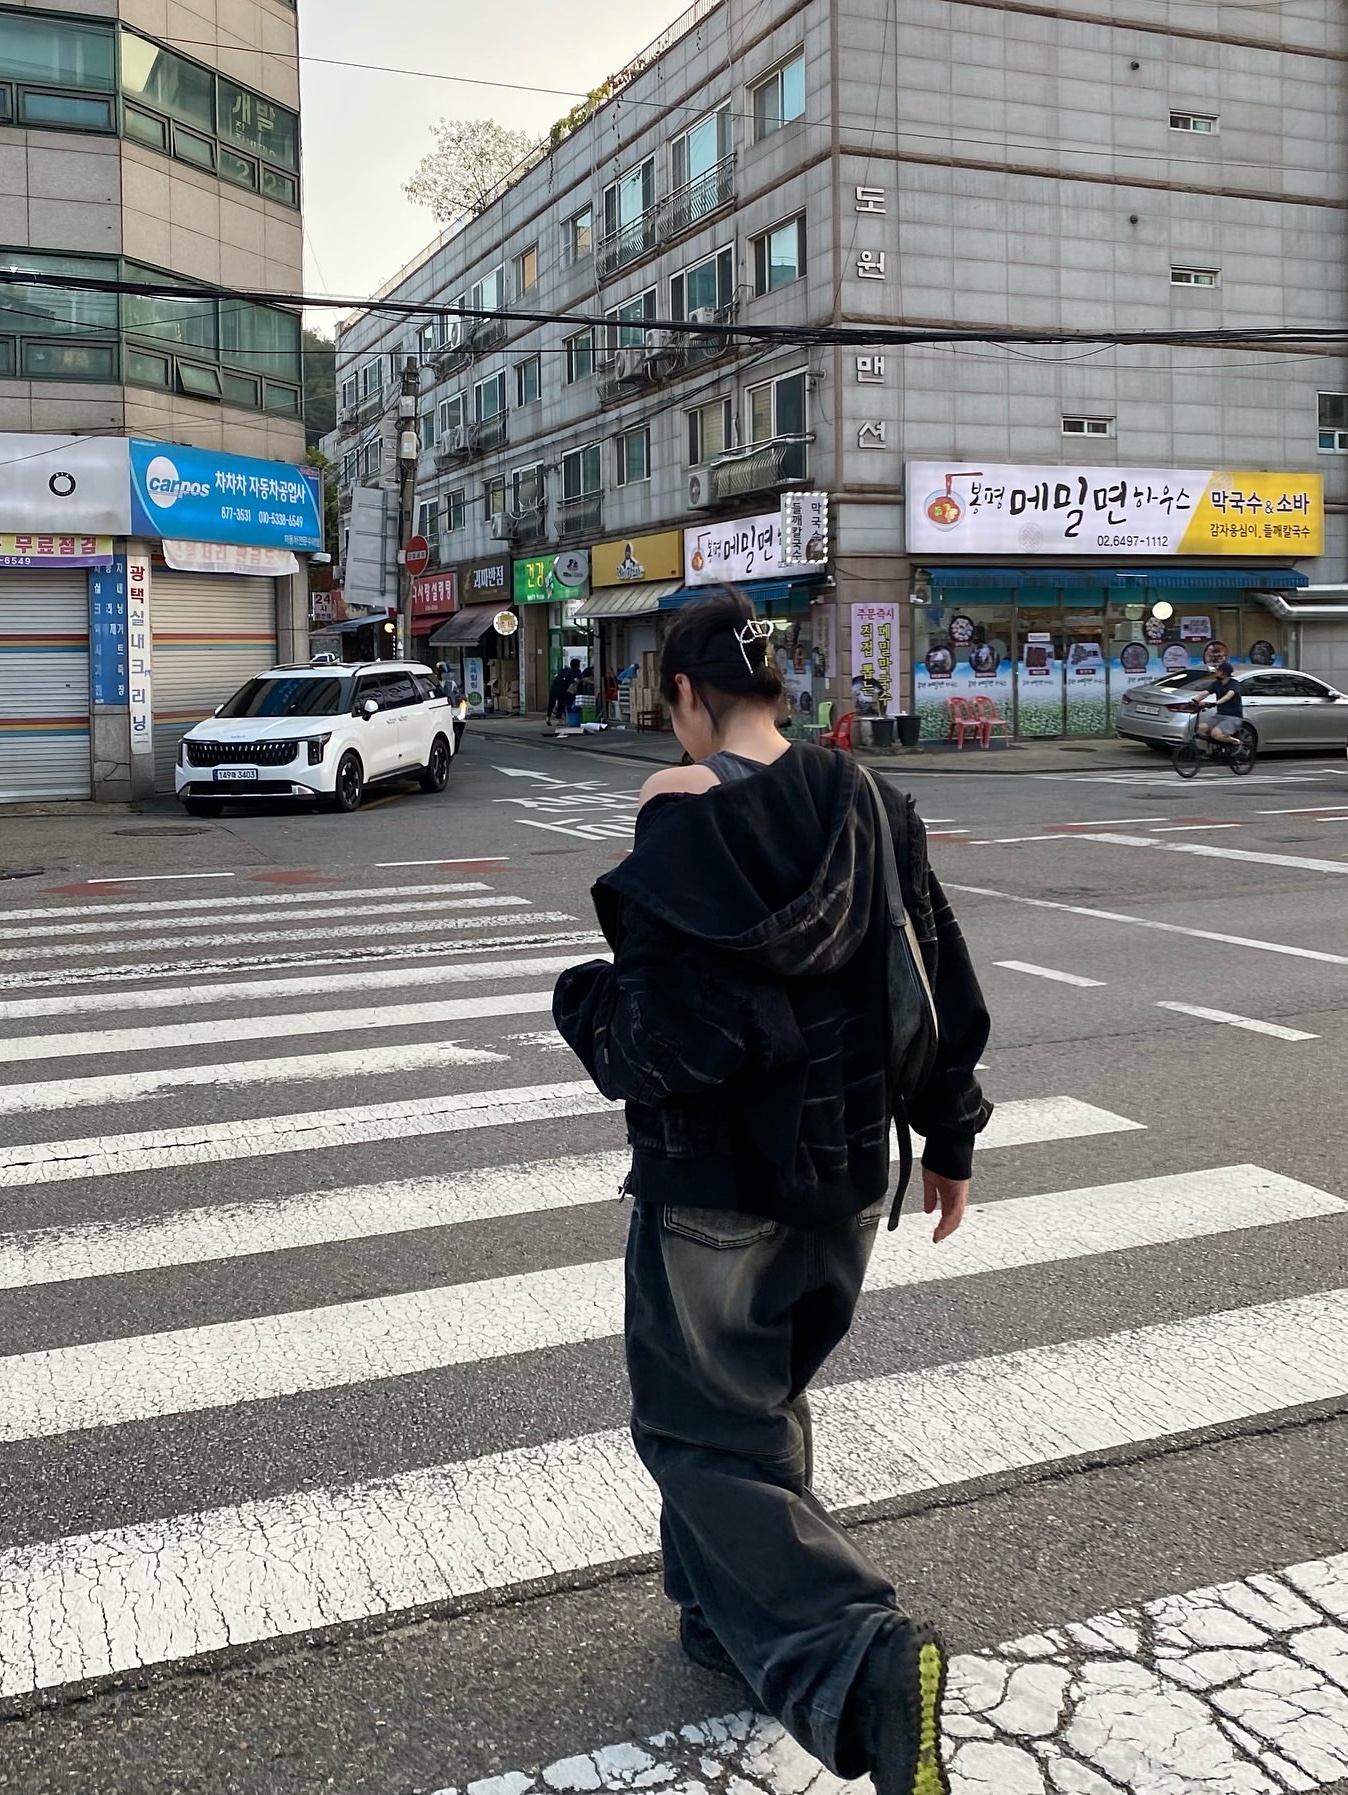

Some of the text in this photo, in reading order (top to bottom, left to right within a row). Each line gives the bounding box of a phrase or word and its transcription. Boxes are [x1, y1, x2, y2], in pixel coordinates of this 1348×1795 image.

[855, 185, 887, 450] 도원맨션
[149, 475, 211, 499] carpos
[214, 470, 306, 504] 차차차 자동차공업사
[221, 506, 251, 522] 877-3531
[811, 502, 826, 541] 막국수
[968, 475, 1191, 538] 봉평 메밀면 하우스
[15, 535, 97, 555] 무료점검
[791, 502, 803, 561] 들깨칼국수
[1096, 535, 1169, 548] 02.6497-1112
[1263, 523, 1311, 539] 들깨칼국수
[724, 524, 774, 574] 메밀면
[130, 565, 146, 604] 광택
[526, 561, 544, 588] 건강
[315, 593, 331, 605] 24
[857, 607, 895, 621] 주문즉시
[860, 623, 874, 657] 직접
[877, 623, 893, 706] 메밀막국수
[237, 771, 256, 779] 3403
